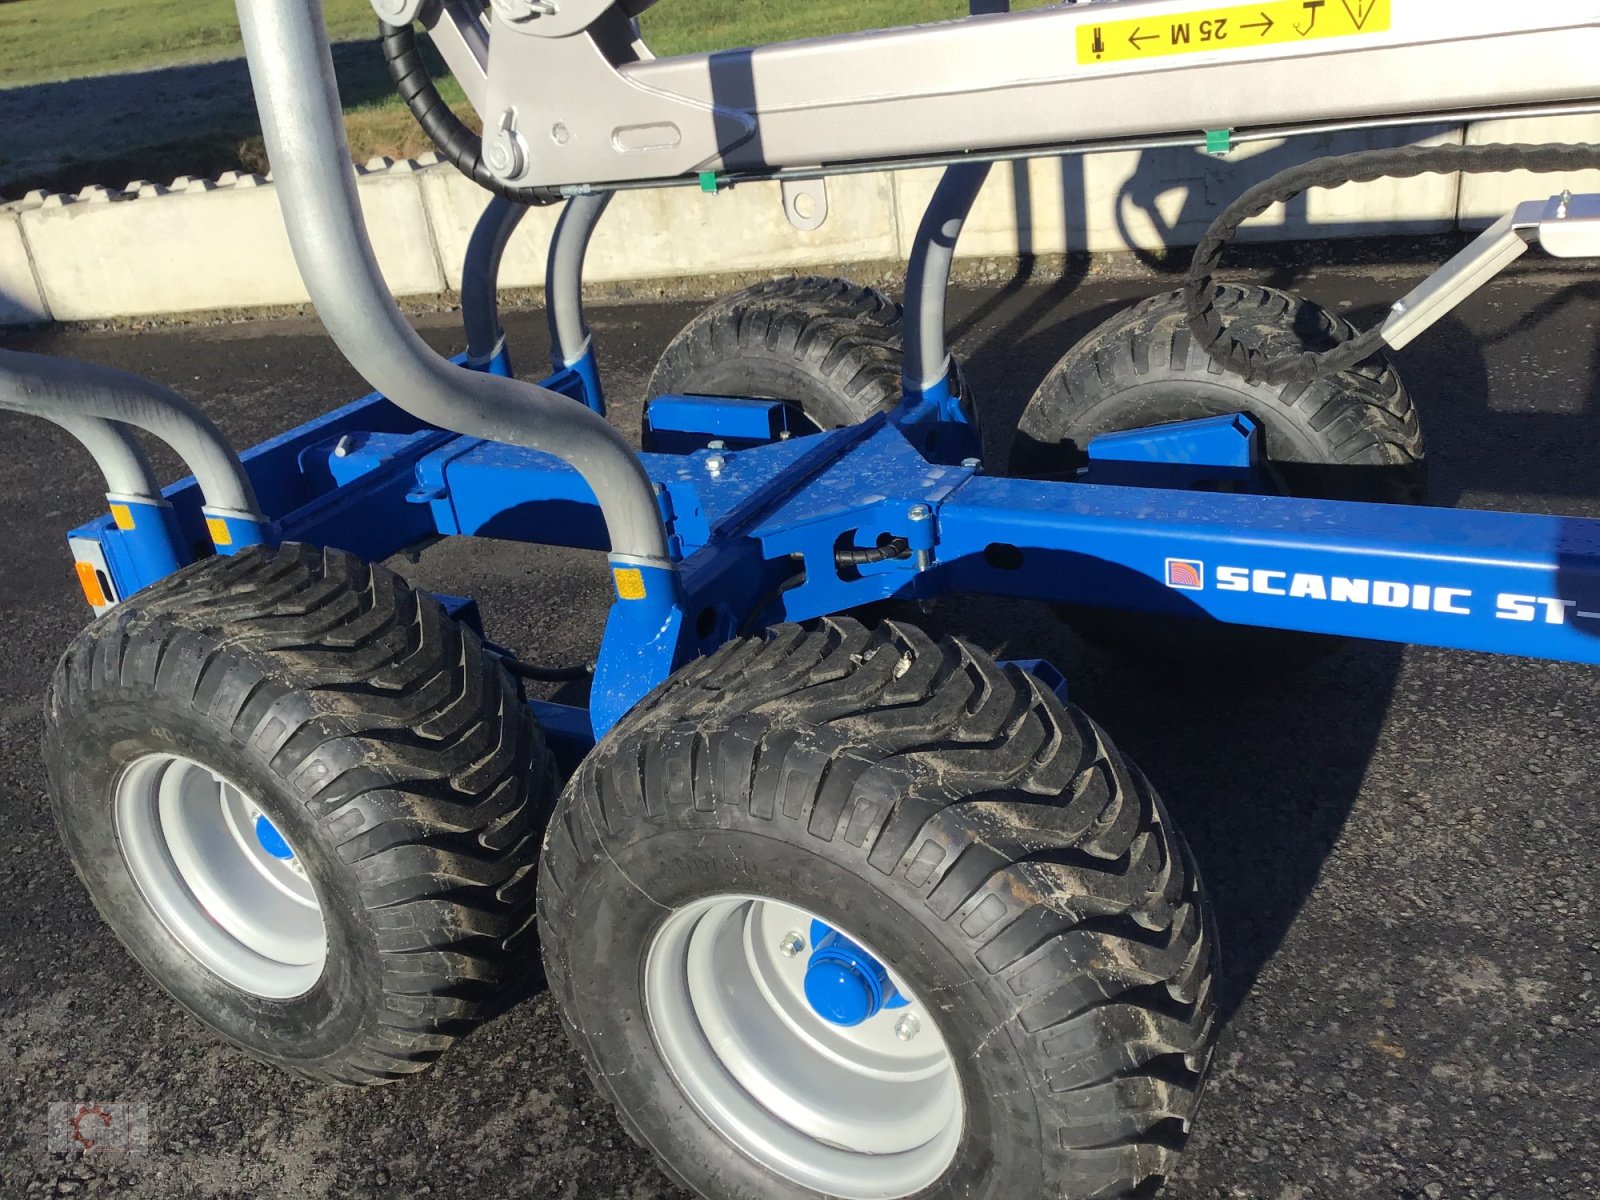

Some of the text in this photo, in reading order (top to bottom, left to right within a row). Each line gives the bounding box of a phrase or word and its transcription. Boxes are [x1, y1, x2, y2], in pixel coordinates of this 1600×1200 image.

[1171, 18, 1228, 45] 25 M
[1216, 565, 1472, 615] SCANDIC
